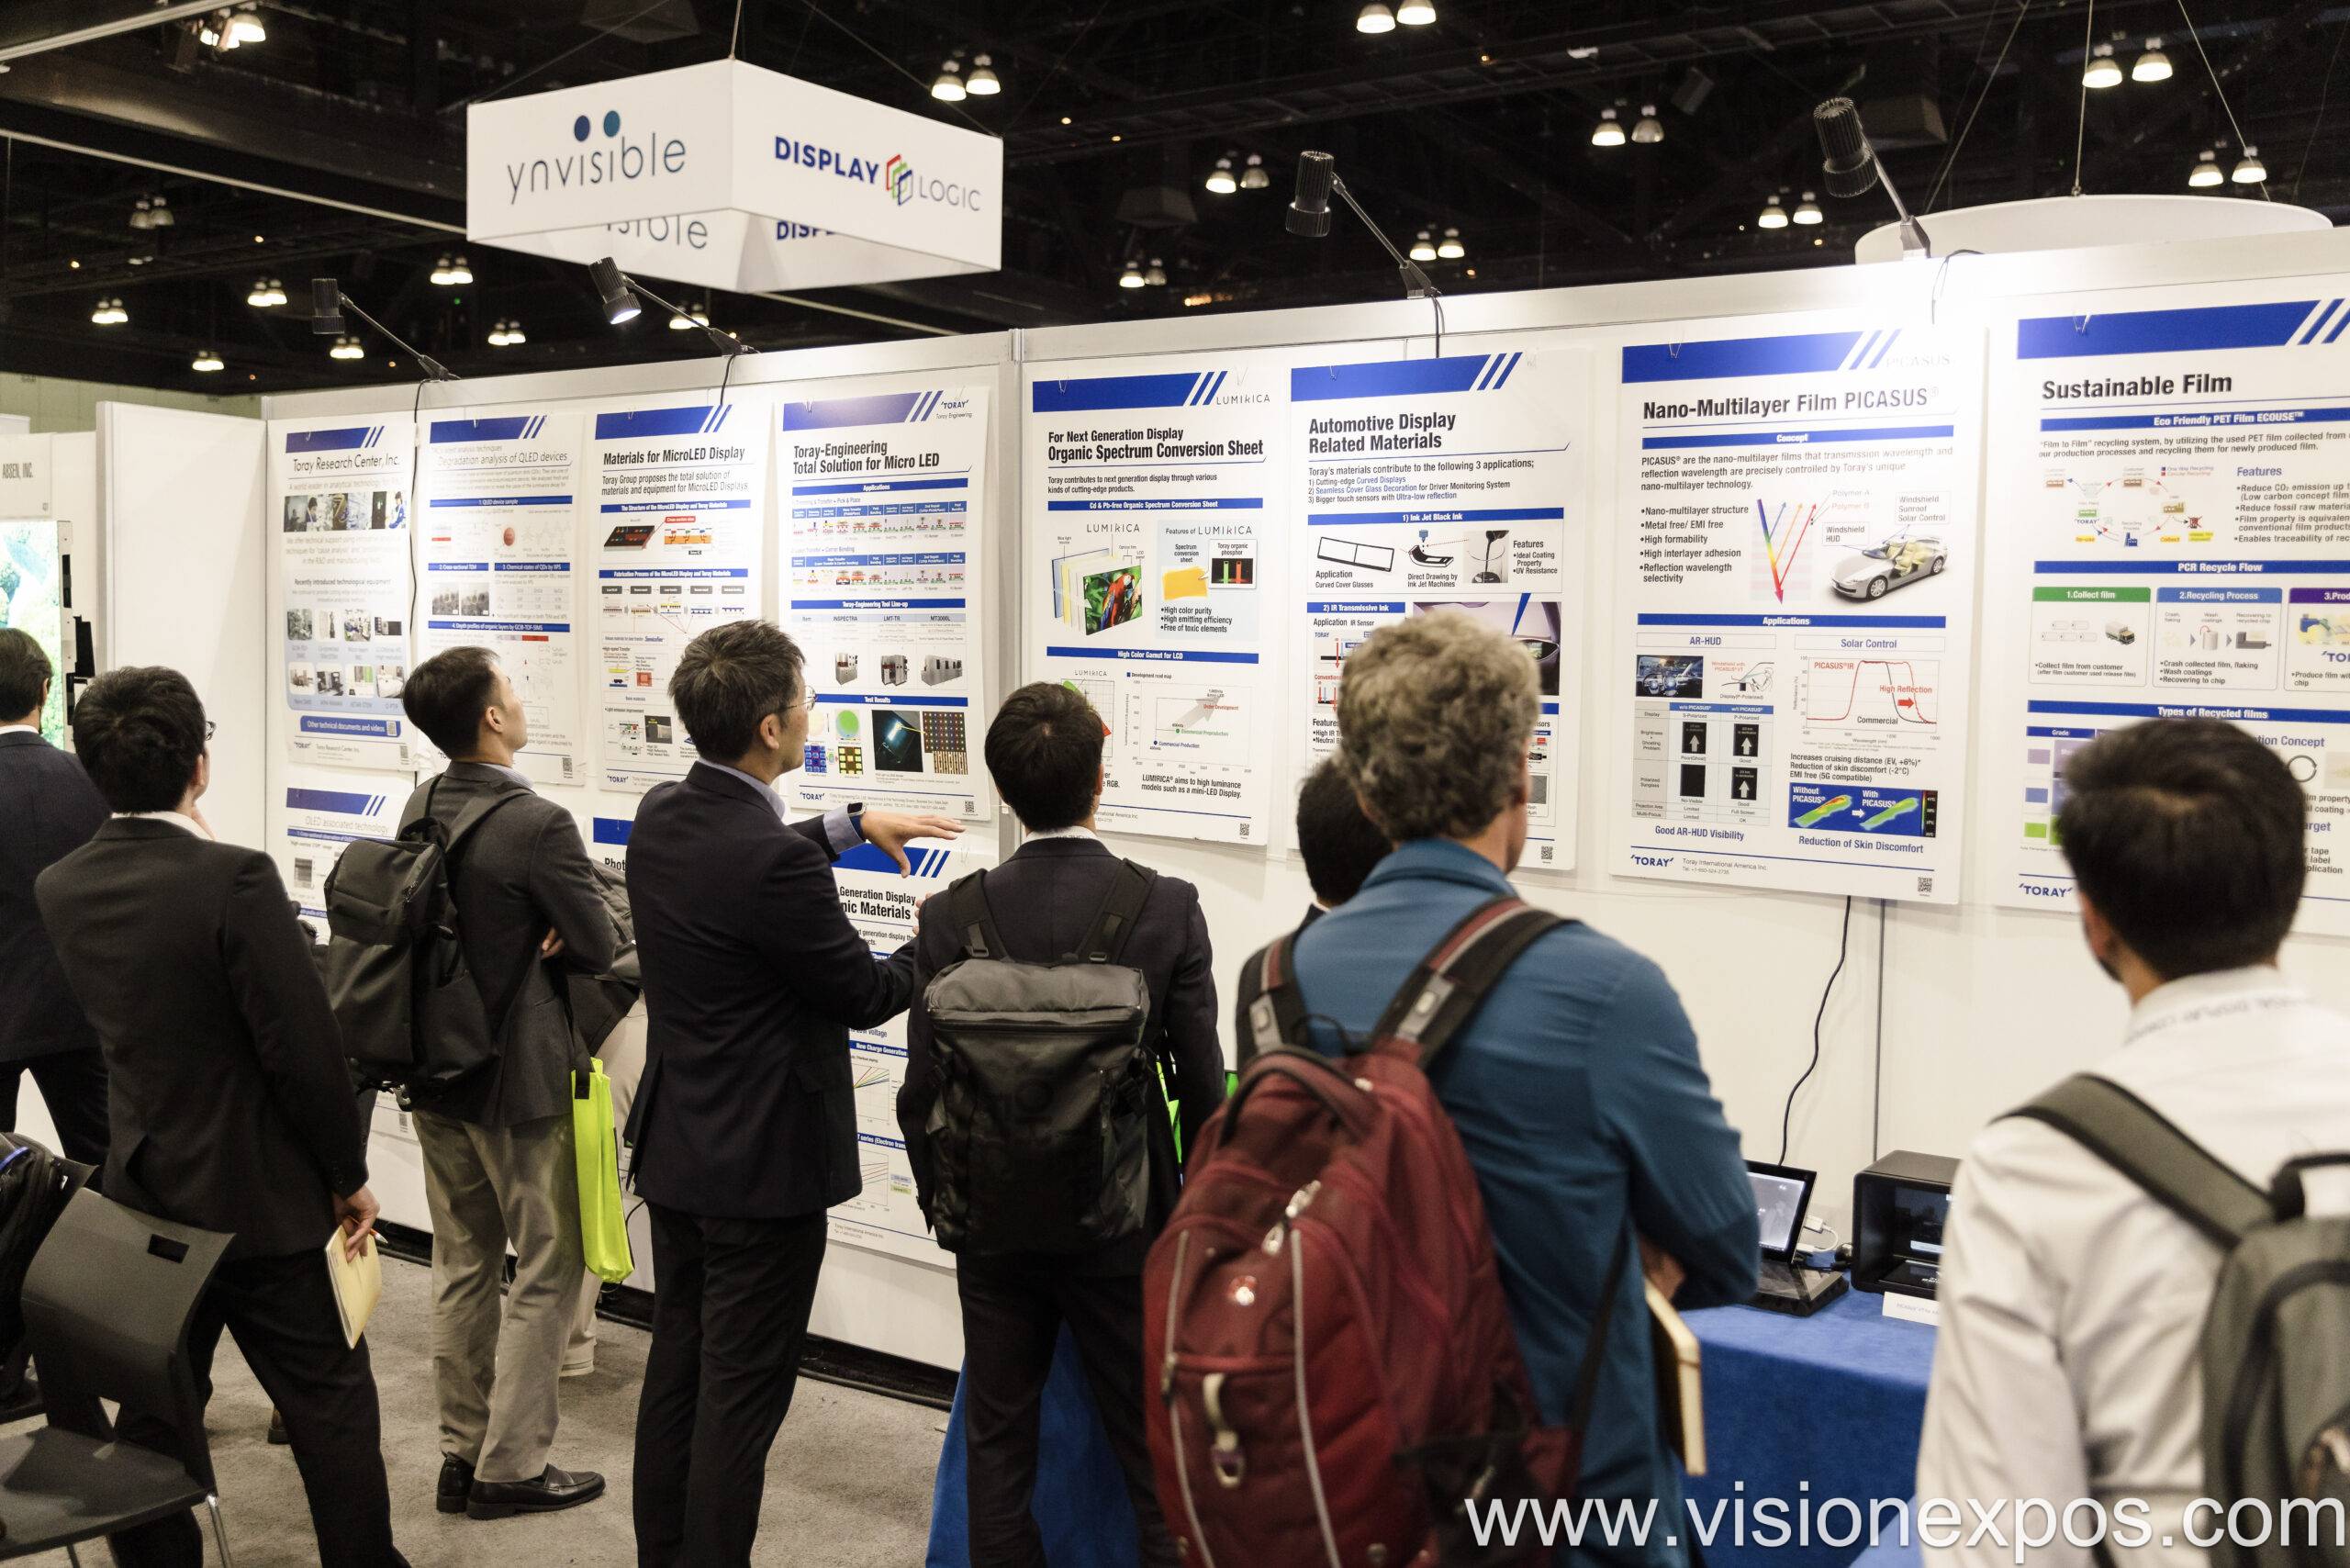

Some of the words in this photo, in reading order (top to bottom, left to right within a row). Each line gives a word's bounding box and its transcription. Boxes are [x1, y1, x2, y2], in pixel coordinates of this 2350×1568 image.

[507, 131, 686, 206] ynvisible
[774, 135, 879, 185] DISPLAY
[919, 174, 981, 212] LOGIC
[2042, 375, 2174, 398] Sustainable
[2182, 373, 2232, 393] Film
[1643, 398, 1790, 419] Nano-Multilayer
[1797, 392, 1836, 411] Film
[1309, 415, 1393, 433] Automotive
[1399, 411, 1456, 432] Display
[1048, 431, 1064, 442] For
[1067, 431, 1088, 442] Next
[1091, 429, 1143, 441] Generation
[1147, 427, 1183, 442] Display
[1776, 433, 1807, 443] Concept
[1309, 435, 1364, 454] Related
[1370, 431, 1441, 450] Materials
[604, 451, 643, 465] Materials
[646, 450, 660, 463] for
[663, 447, 706, 462] MicroLED
[709, 445, 744, 462] Display
[793, 441, 887, 459] Toray-Engineering
[1048, 444, 1092, 464] Organic
[1096, 442, 1152, 462] Spectrum
[1157, 441, 1224, 457] Conversion
[1227, 440, 1263, 455] Sheet
[793, 460, 816, 474] Total
[820, 457, 862, 473] Solution
[866, 456, 881, 470] for
[884, 454, 915, 469] Micro
[918, 453, 939, 466] LED
[1309, 466, 1334, 477] Toray's
[1336, 465, 1371, 475] materials
[1372, 463, 1411, 473] contribute
[1414, 463, 1421, 472] to
[1423, 462, 1435, 471] the
[1438, 461, 1473, 472] following
[1475, 460, 1481, 469] 3
[1483, 458, 1534, 470] applications;
[2236, 465, 2282, 476] Features
[1048, 476, 1063, 486] Toray
[1103, 475, 1116, 483] next
[1117, 475, 1147, 484] generation
[1149, 474, 1169, 483] display
[1171, 474, 1193, 483] through
[1195, 473, 1217, 481] various
[1645, 505, 1709, 517] Nano-multilayer
[1711, 505, 1749, 514] structure
[1645, 521, 1667, 530] Metal
[1669, 521, 1688, 531] free/
[1690, 520, 1705, 529] EMI
[1707, 520, 1723, 528] free
[1513, 539, 1543, 548] Features
[1645, 534, 1662, 545] High
[1664, 534, 1707, 544] formability
[1826, 534, 1840, 543] HUD
[1532, 551, 1554, 560] Coating
[1644, 549, 1662, 559] High
[1663, 548, 1702, 559] interlayer
[1704, 548, 1740, 557] adhesion
[1516, 559, 1541, 567] Property
[1643, 563, 1683, 571] Reflection
[1685, 563, 1731, 573] wavelength
[2178, 563, 2196, 571] PCR
[2199, 563, 2236, 573] Recycle
[2239, 563, 2262, 571] Flow
[1315, 569, 1352, 579] Application
[1643, 573, 1683, 584] selectivity
[2066, 589, 2098, 599] 1.Collect
[2100, 589, 2115, 599] film
[2179, 591, 2224, 600] 2.Recycling
[2226, 591, 2258, 599] Process
[1163, 606, 1177, 615] High
[1194, 606, 1212, 615] purity
[1323, 604, 1329, 612] 2)
[1762, 617, 1809, 626] Applications
[1689, 636, 1721, 645] AR-HUD
[1841, 639, 1863, 647] Solar
[1865, 639, 1897, 647] Control
[1880, 685, 1895, 693] High
[1897, 685, 1932, 693] Reflection
[2158, 706, 2183, 718] Types
[2186, 707, 2196, 716] of
[2199, 708, 2241, 720] Recycled
[2244, 709, 2267, 719] films
[1857, 715, 1897, 724] Commercial
[1793, 785, 1818, 794] Without
[1862, 788, 1878, 798] With
[1655, 825, 1674, 834] Good
[1676, 827, 1707, 837] AR-HUD
[1709, 829, 1744, 841] Visibility
[1799, 835, 1841, 846] Reduction
[1843, 838, 1852, 847] of
[1854, 839, 1873, 849] Skin
[1875, 841, 1923, 853] Discomfort
[839, 887, 883, 900] Generation
[886, 891, 916, 905] Display
[861, 902, 911, 920] Materials
